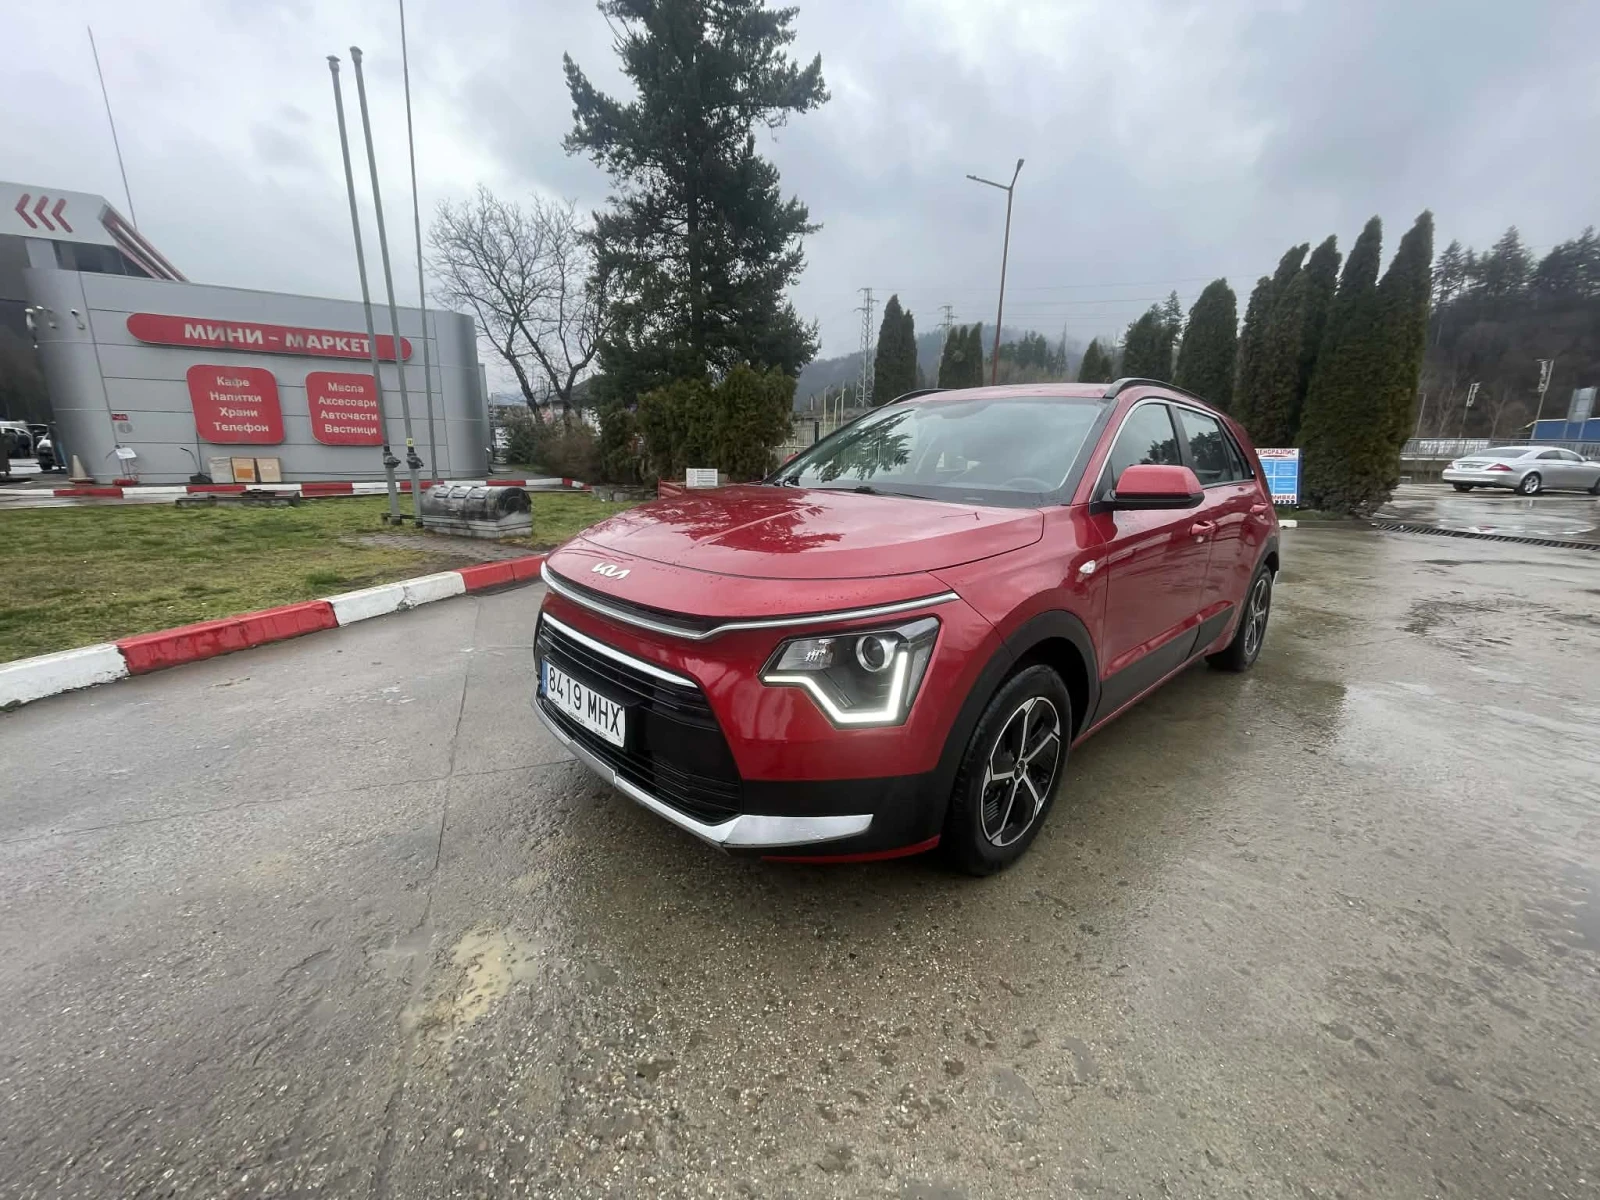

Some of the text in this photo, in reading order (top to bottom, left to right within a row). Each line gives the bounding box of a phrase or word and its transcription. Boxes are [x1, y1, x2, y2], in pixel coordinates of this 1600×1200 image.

[184, 323, 264, 344] МИНИ
[285, 333, 371, 353] МАРКЕТ
[216, 376, 250, 388] Кафе
[327, 382, 364, 393] Масла
[209, 391, 262, 402] Напитки
[318, 396, 377, 408] Аксесоари
[219, 407, 258, 418] Храни
[320, 410, 377, 420] Авточасти
[213, 422, 269, 433] Телефон
[591, 562, 631, 580] KIA
[549, 667, 622, 737] 8419 MHX
